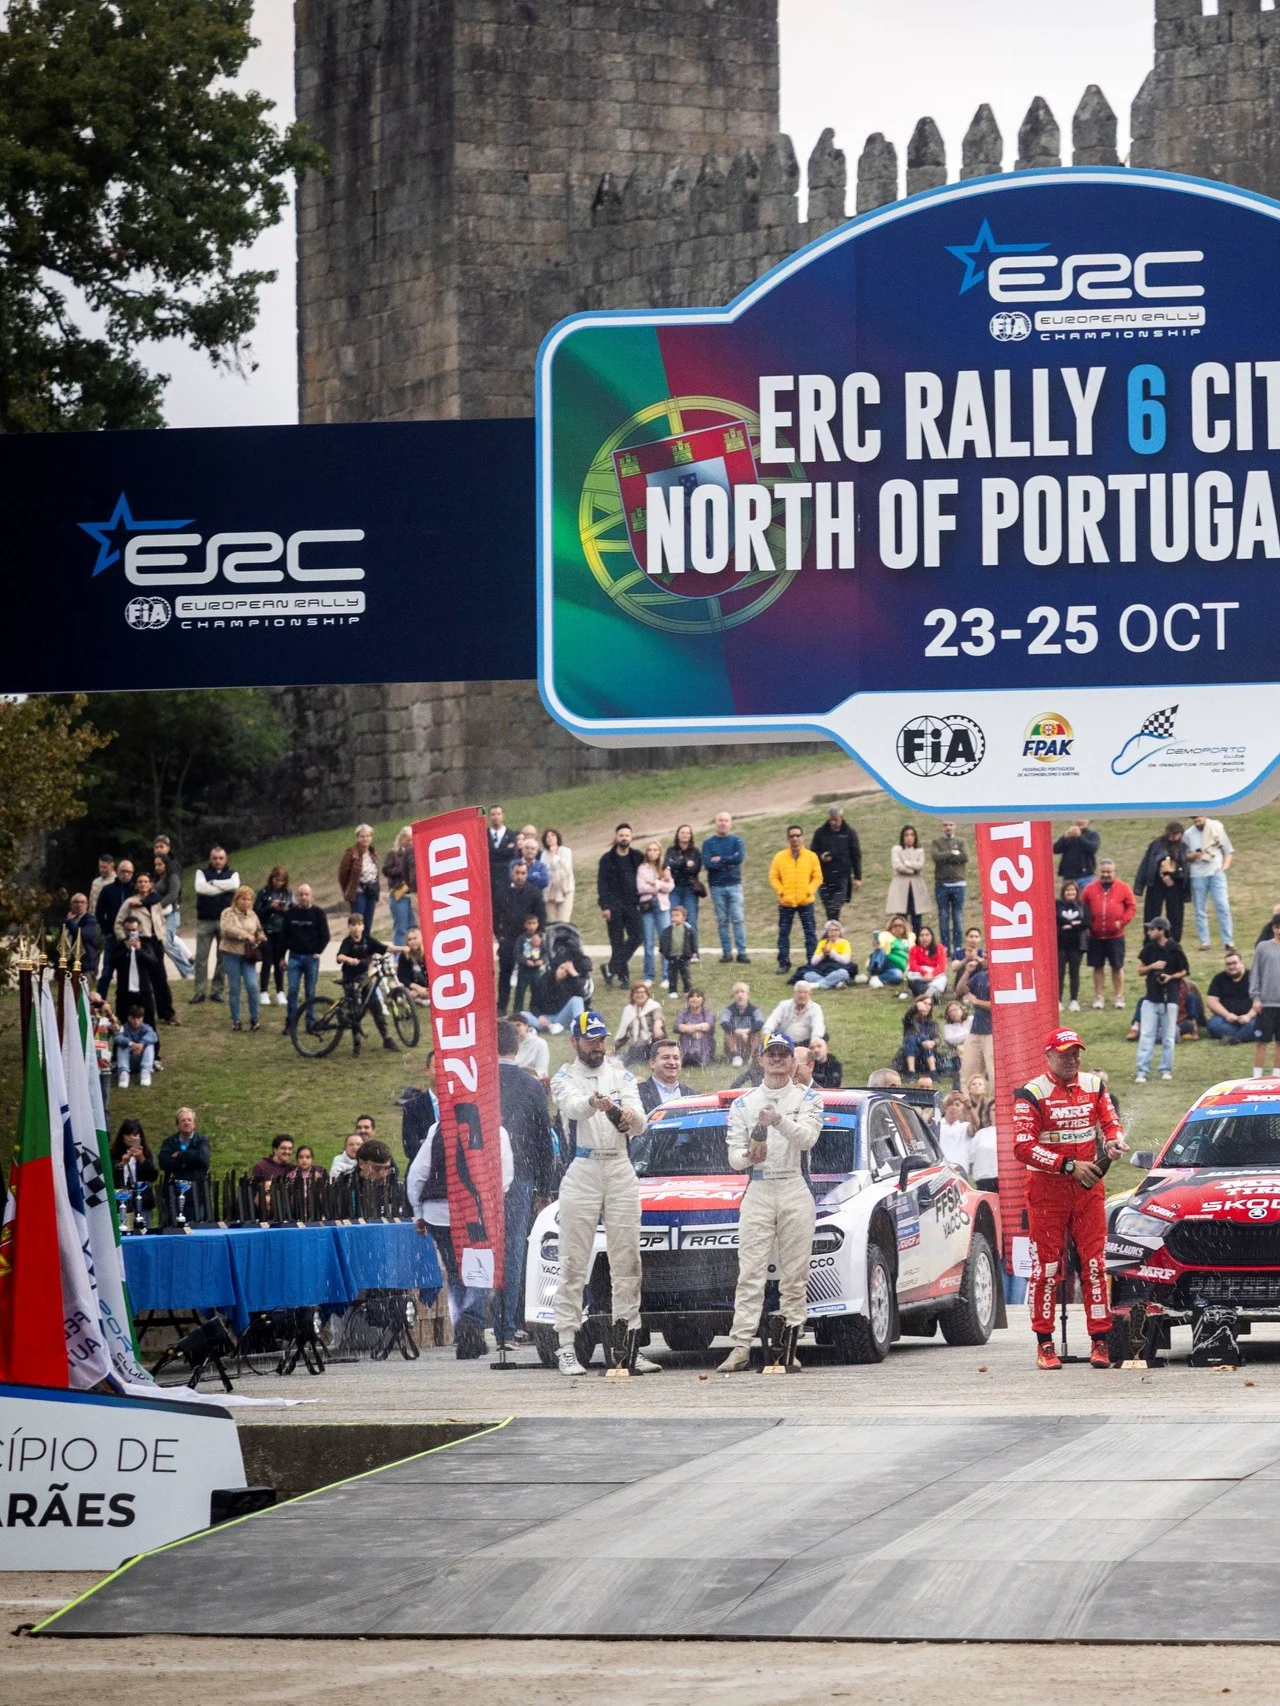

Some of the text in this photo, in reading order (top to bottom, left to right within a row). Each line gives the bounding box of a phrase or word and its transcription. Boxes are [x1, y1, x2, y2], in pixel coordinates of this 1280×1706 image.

[988, 250, 1205, 302] ERC
[1040, 313, 1136, 325] EUROPEAN
[1142, 311, 1200, 322] RALLY
[1040, 328, 1201, 341] CHAMPIONSHIP
[759, 371, 882, 464] ERC
[905, 366, 1106, 461] RALLY
[1127, 363, 1167, 455] 6
[645, 480, 855, 574] NORTH
[879, 477, 960, 569] OF
[124, 528, 365, 586] ERC
[181, 600, 288, 612] EUROPEAN
[294, 598, 359, 608] RALLY
[181, 616, 360, 629] CHAMPIONSHIP
[924, 601, 1240, 658] 23-25 OCT
[1022, 739, 1074, 757] FPAK
[1166, 746, 1246, 755] DEMOPORTO
[1050, 1103, 1094, 1119] MRF
[809, 1256, 835, 1270] CCO
[1137, 1264, 1177, 1280] MRF
[0, 1427, 179, 1473] ÍPIO DE
[0, 1482, 137, 1527] RÃES
